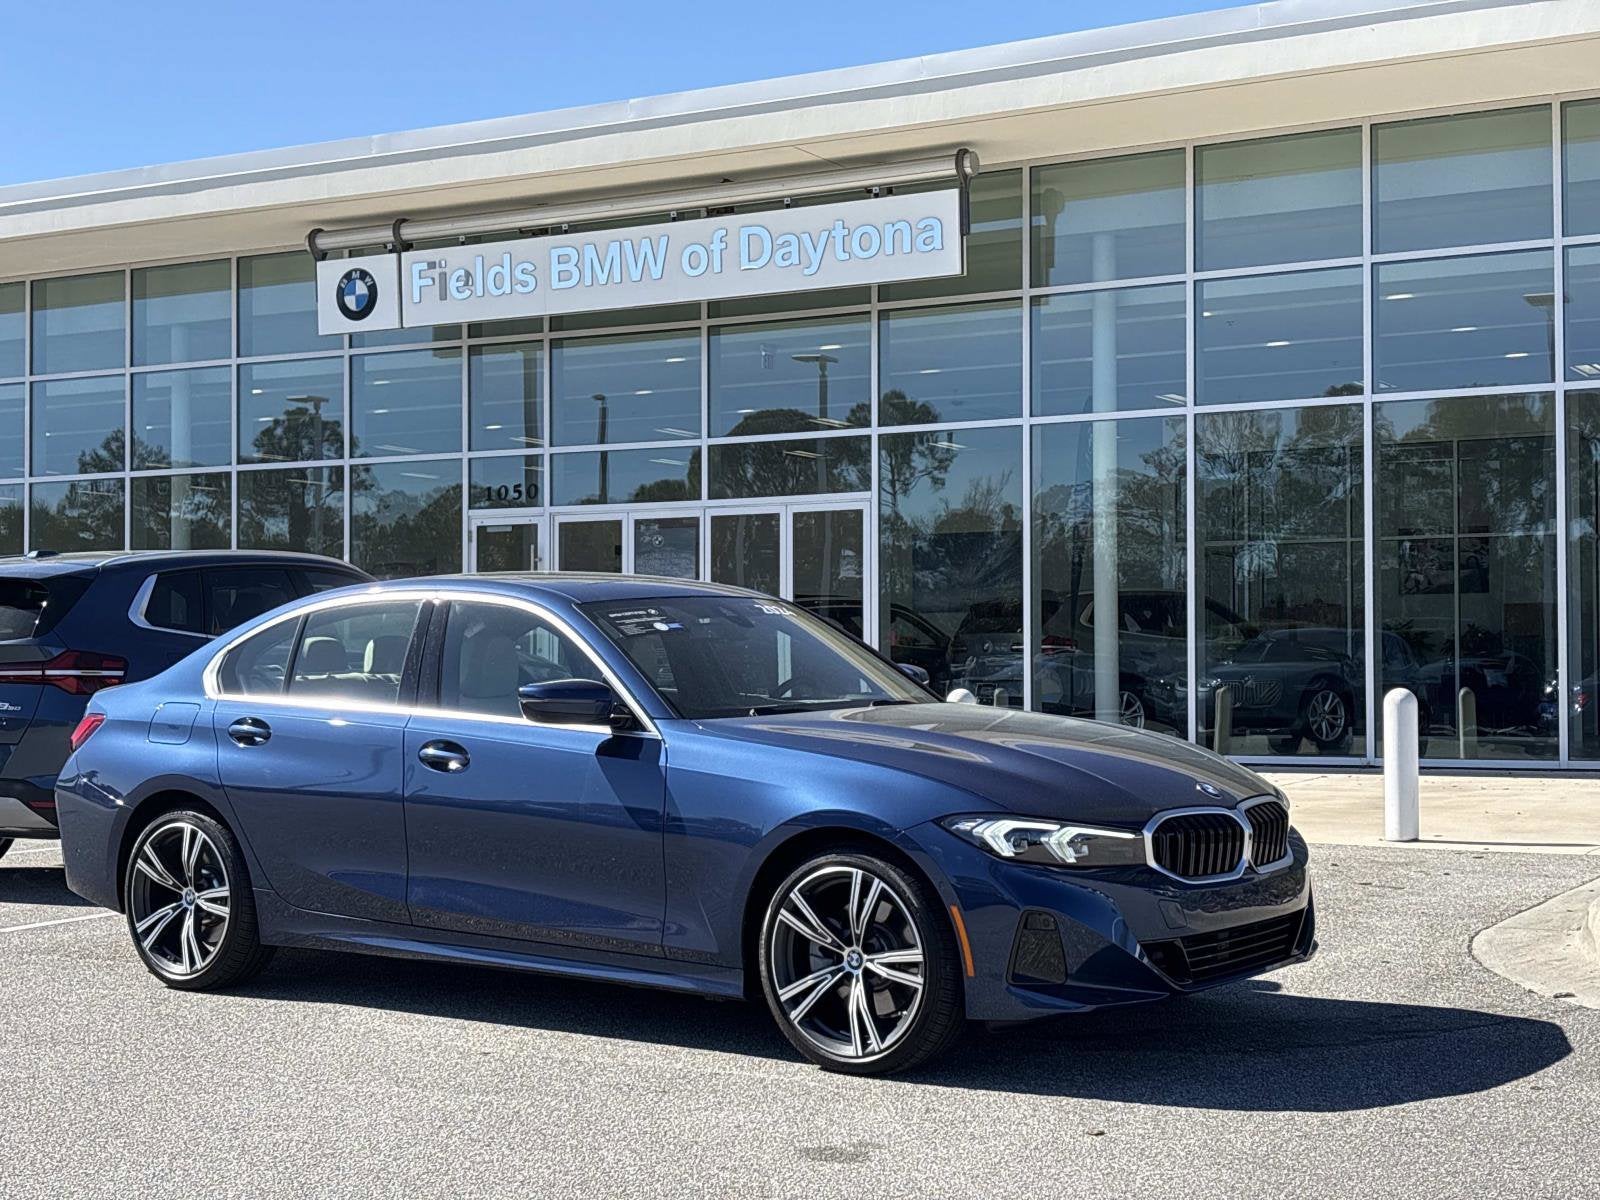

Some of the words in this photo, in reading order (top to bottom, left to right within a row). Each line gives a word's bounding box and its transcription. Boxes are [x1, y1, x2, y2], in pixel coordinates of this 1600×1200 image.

[411, 252, 538, 304] Fields
[550, 235, 669, 290] BMW
[681, 227, 728, 277] of
[739, 216, 944, 276] Daytona
[485, 482, 539, 501] 1050
